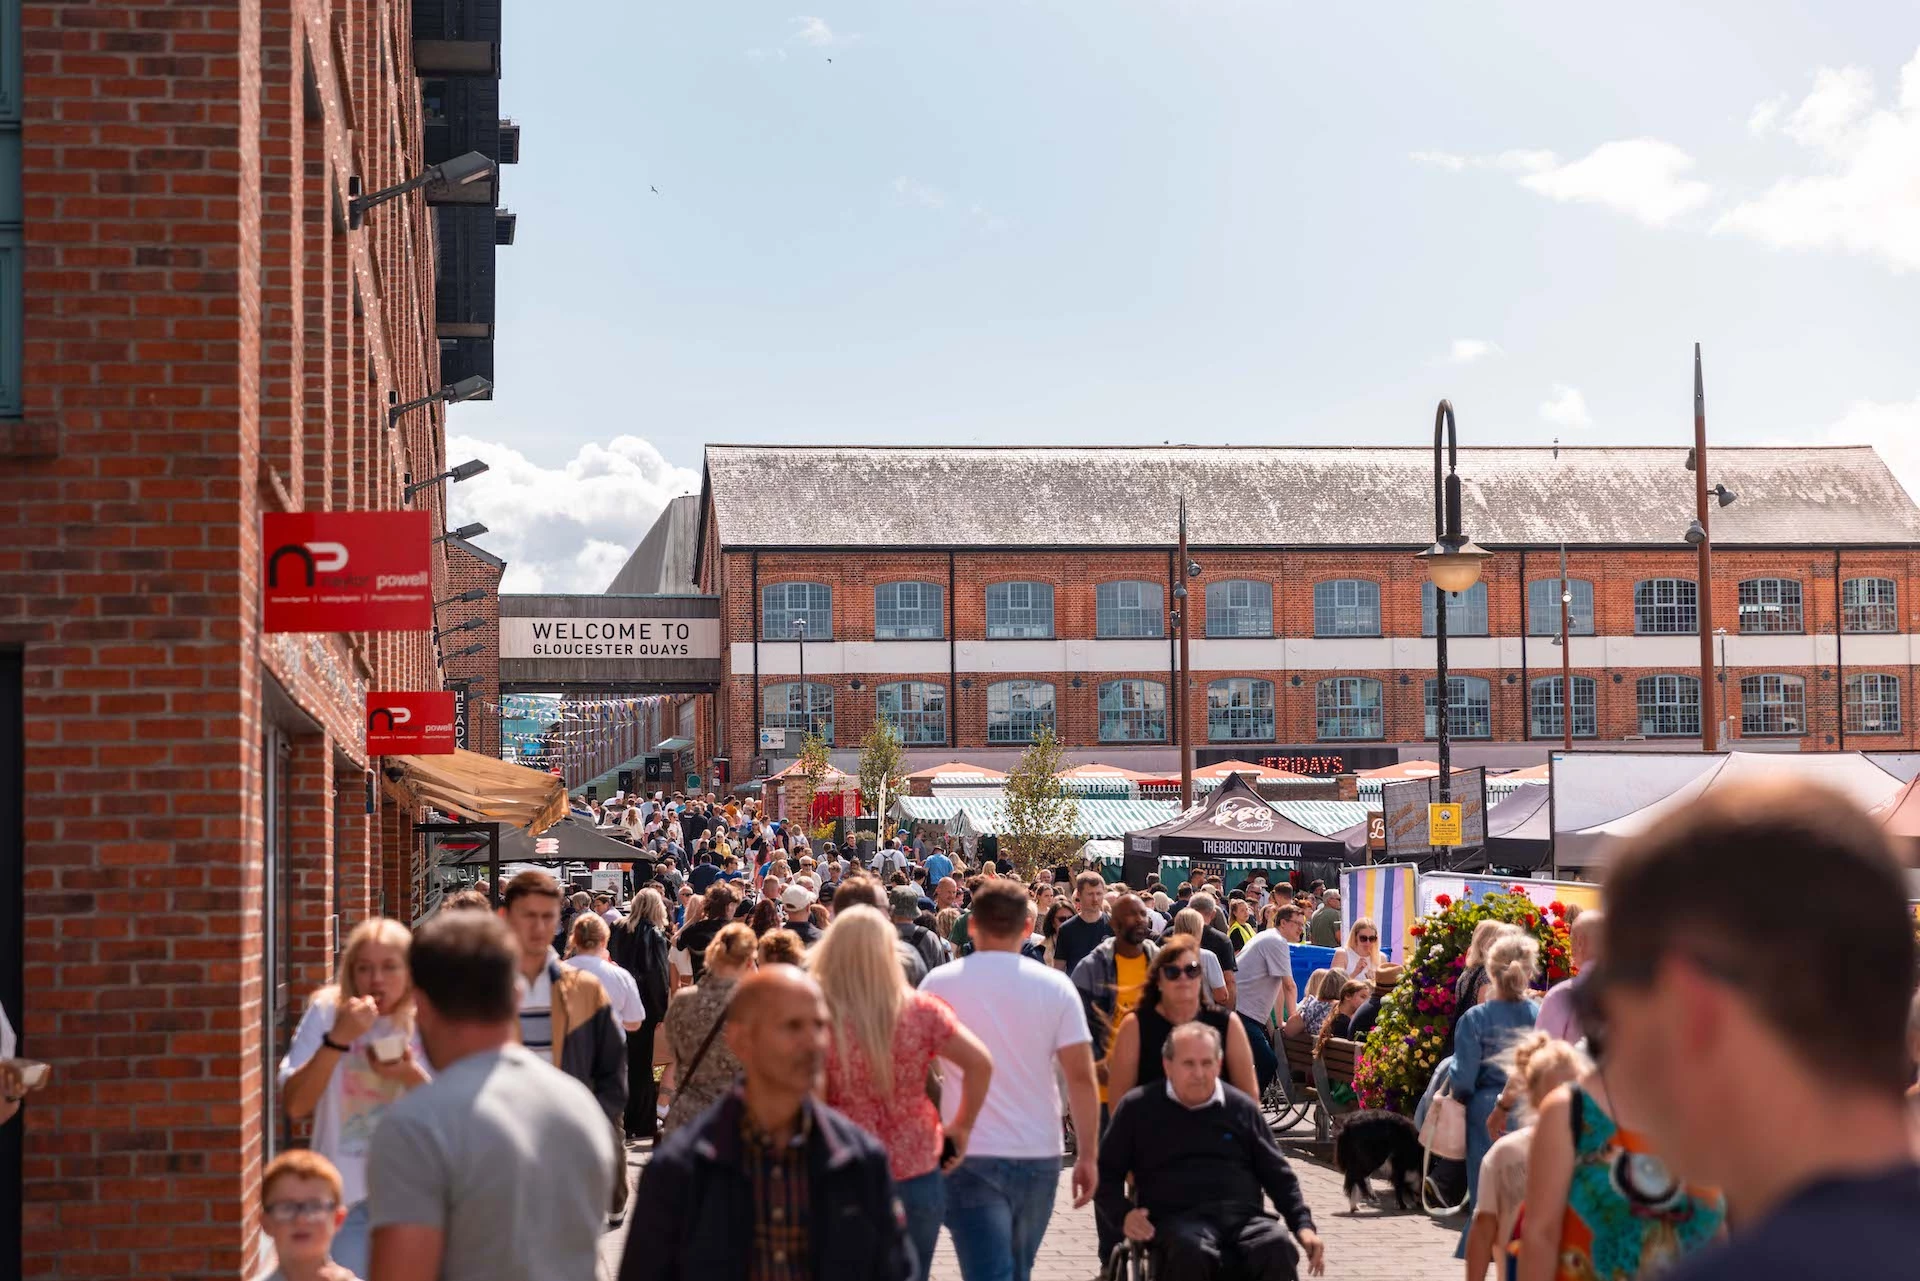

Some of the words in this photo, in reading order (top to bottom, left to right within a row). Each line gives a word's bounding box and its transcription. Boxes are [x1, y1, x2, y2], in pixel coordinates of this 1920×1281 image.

[376, 571, 429, 590] powell
[532, 623, 652, 640] WELCOME
[662, 623, 690, 640] TO
[533, 643, 633, 655] GLOUCESTER
[640, 643, 689, 655] QUAYS
[425, 723, 453, 733] powell
[1202, 840, 1302, 857] THEBBQSOCIETY.CO.UK
